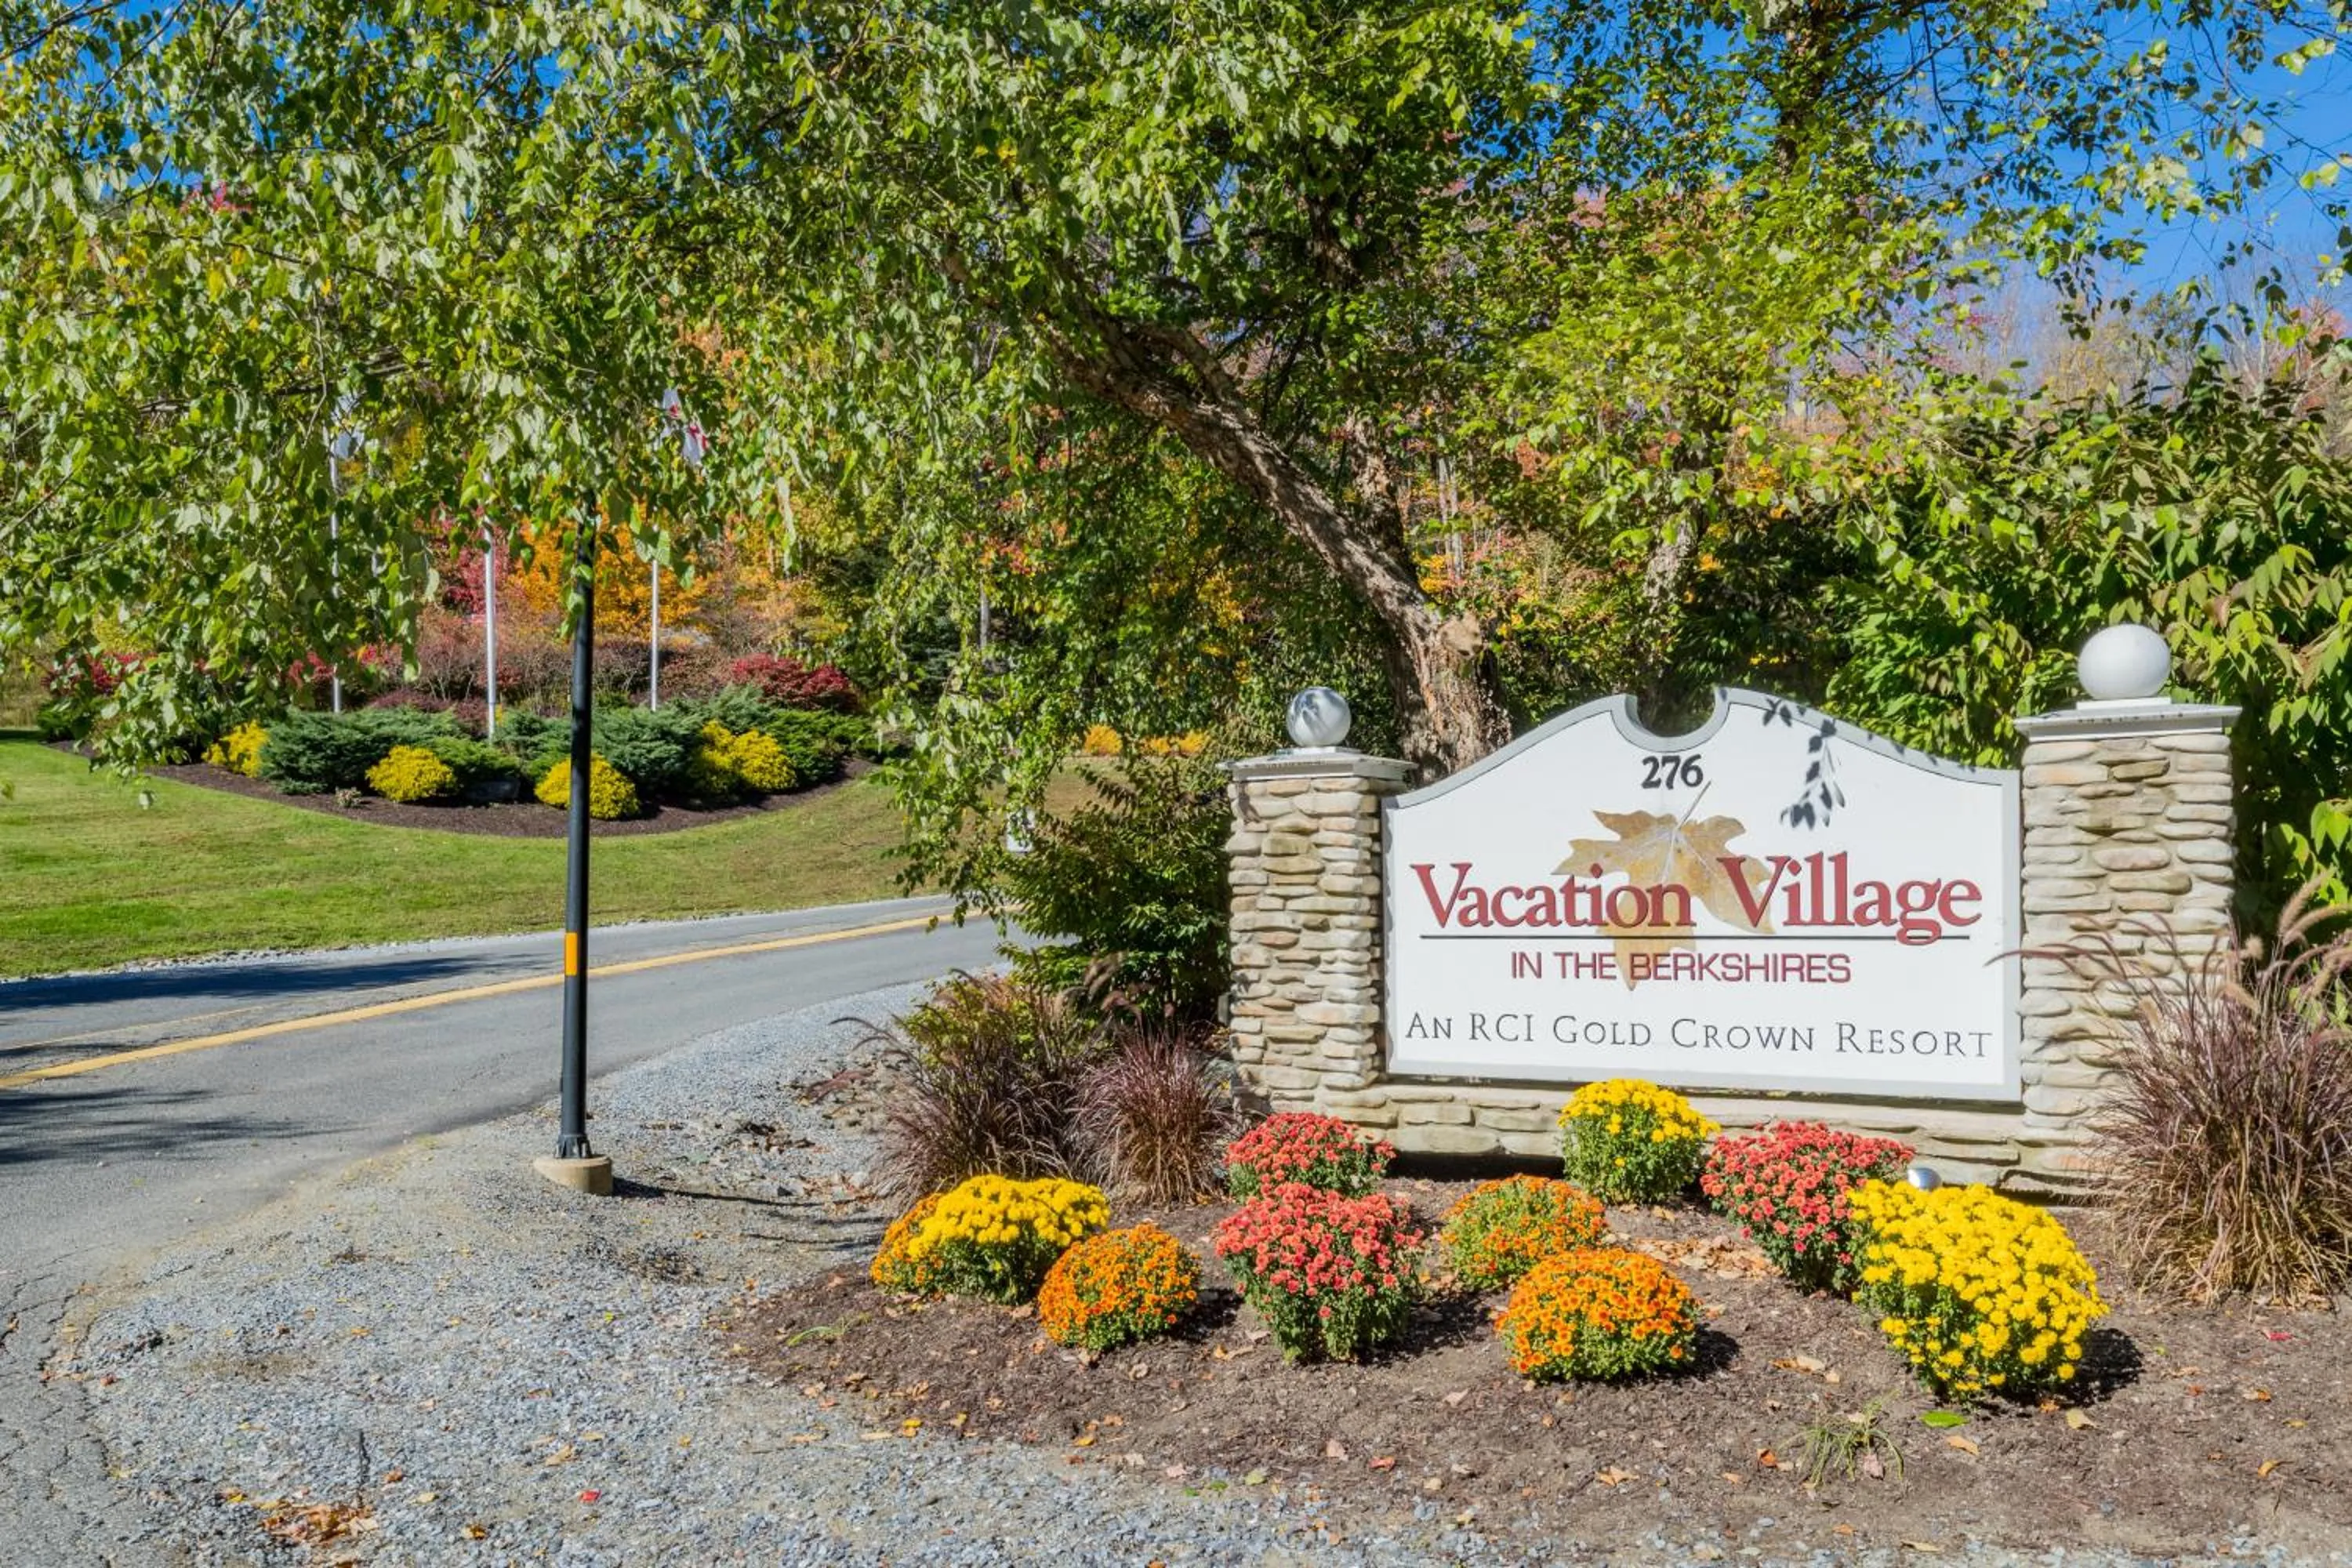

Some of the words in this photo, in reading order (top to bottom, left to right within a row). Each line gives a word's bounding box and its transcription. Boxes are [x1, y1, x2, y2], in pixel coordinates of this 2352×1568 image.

[1641, 754, 1704, 789] 276
[1409, 862, 1696, 929] Vacation
[1717, 851, 1982, 946] Village
[1512, 951, 1542, 979] IN
[1552, 951, 1617, 980] THE
[1630, 952, 1852, 984] BERKSHIRES
[1469, 1013, 1534, 1043] RCI
